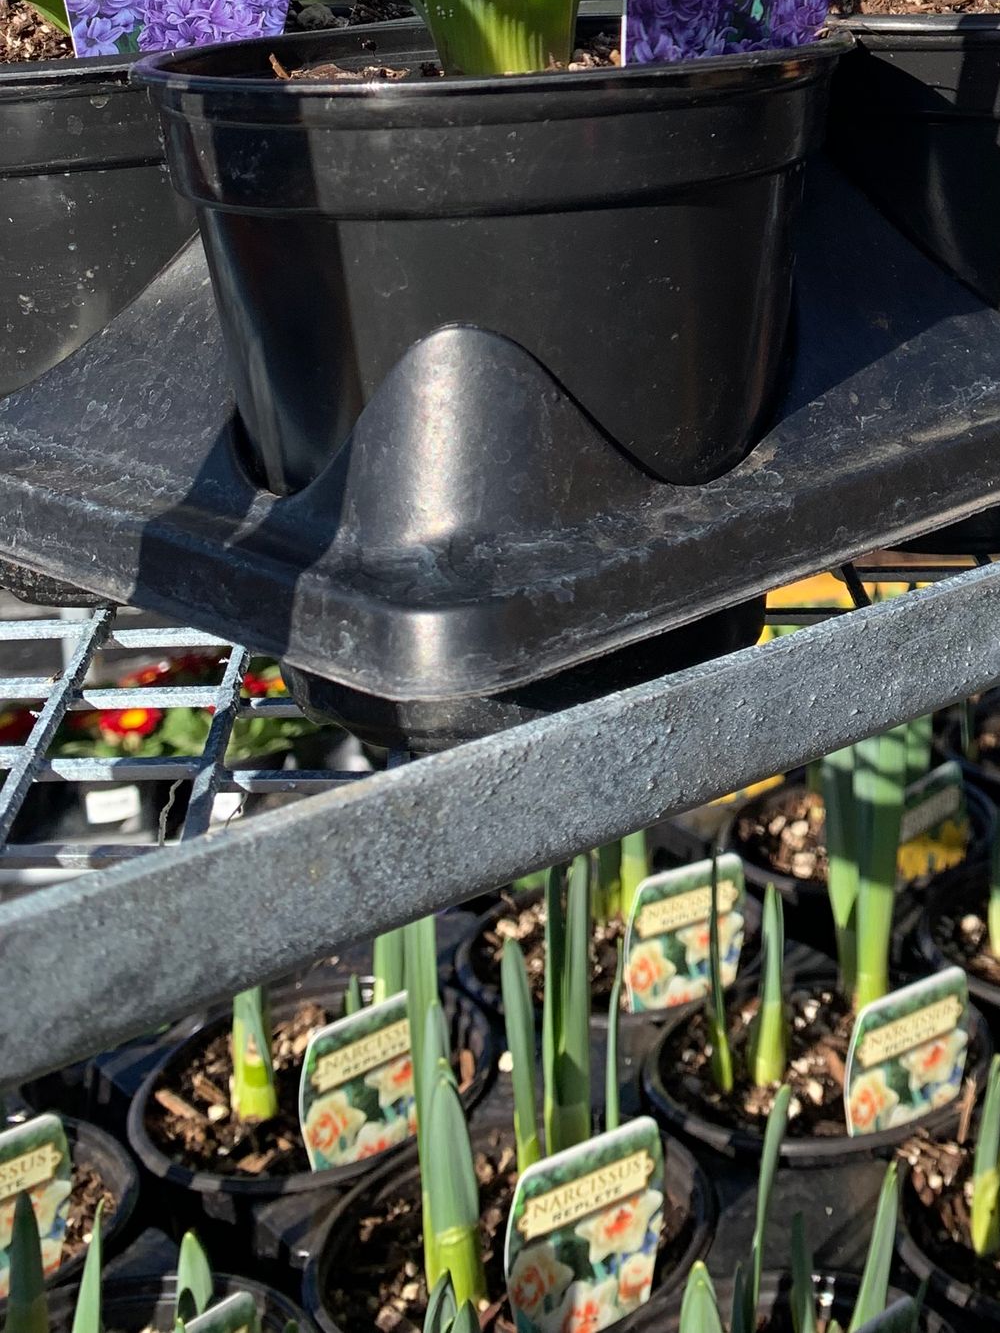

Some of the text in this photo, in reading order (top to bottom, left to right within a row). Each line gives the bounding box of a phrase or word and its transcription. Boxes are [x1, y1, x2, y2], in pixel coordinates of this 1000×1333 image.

[867, 1003, 955, 1050] NARCISSUS
[533, 1159, 642, 1218] NARCISSUS
[552, 1185, 623, 1223] REPLETE
